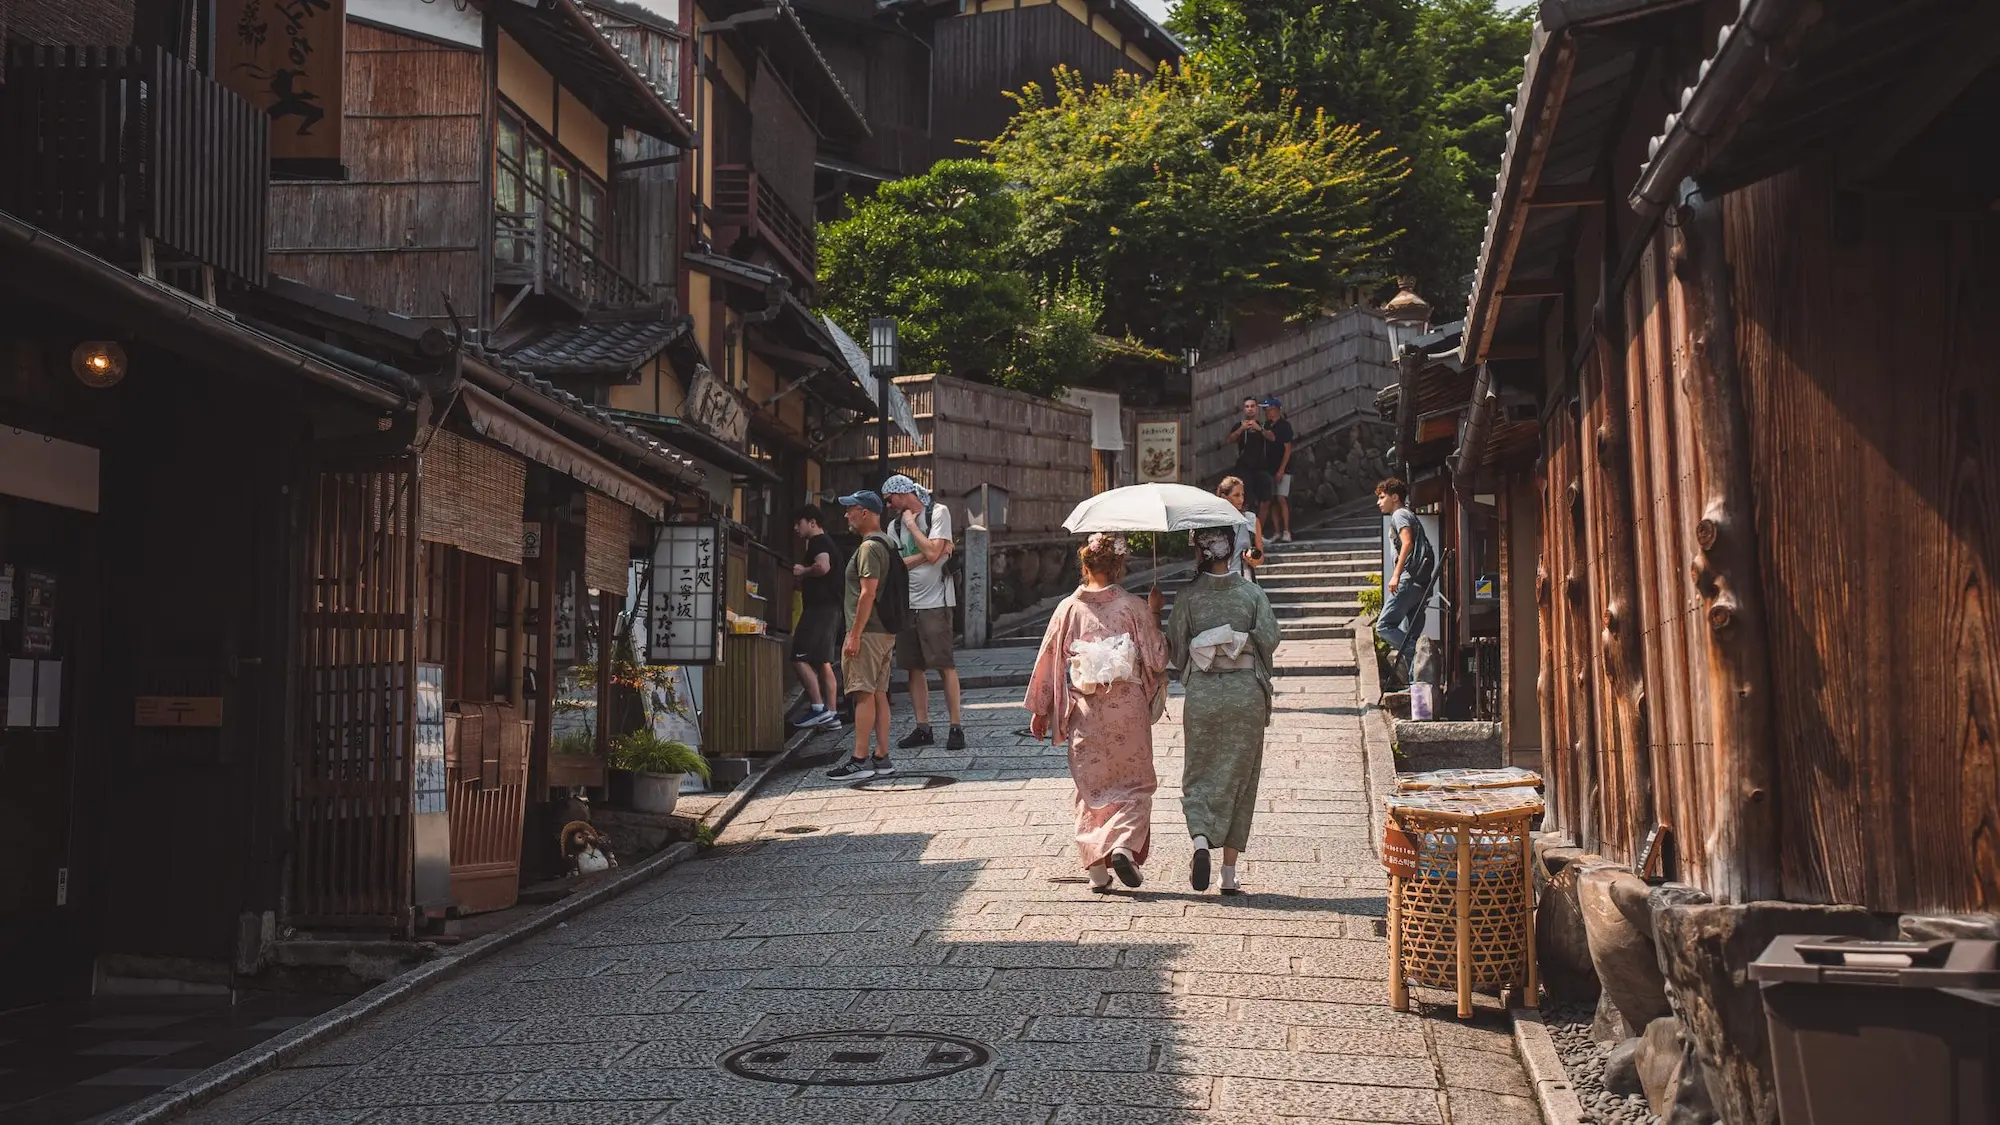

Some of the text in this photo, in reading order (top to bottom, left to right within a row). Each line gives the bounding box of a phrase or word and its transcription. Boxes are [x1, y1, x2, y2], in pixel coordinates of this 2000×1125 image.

[697, 538, 711, 588] そば処
[677, 569, 694, 618] 二寧坂
[655, 594, 676, 648] ふたば
